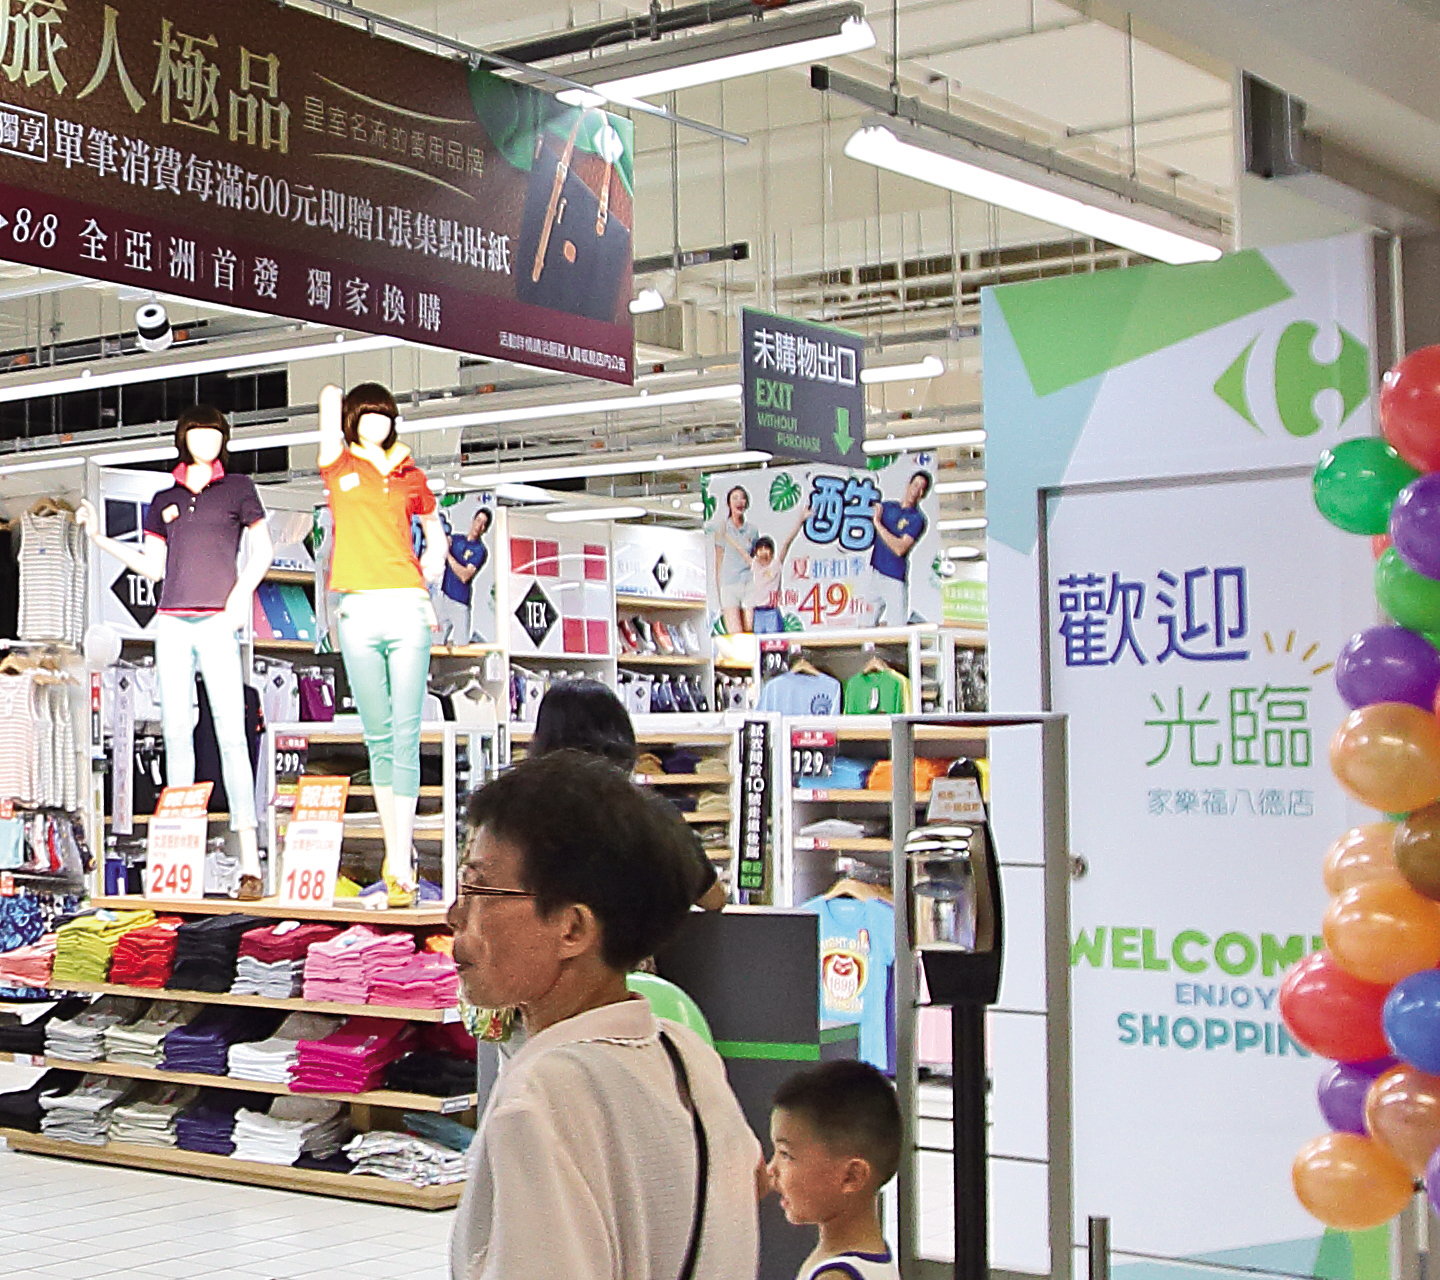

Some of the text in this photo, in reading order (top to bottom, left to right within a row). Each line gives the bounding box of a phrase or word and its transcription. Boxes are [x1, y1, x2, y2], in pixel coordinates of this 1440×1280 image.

[12, 207, 59, 249] 8/8
[306, 268, 442, 333] 獨家換購
[753, 327, 857, 387] 未購物出口
[756, 378, 795, 411] EXIT
[757, 412, 798, 433] WITHOUT
[776, 432, 821, 453] PURCHASE
[803, 475, 882, 551] 酷
[658, 562, 670, 580] TEX
[126, 574, 157, 606] TEX
[526, 601, 548, 629] TEX
[1057, 566, 1252, 668] 歡迎
[1144, 683, 1313, 768] 光臨
[276, 752, 299, 772] 299
[793, 751, 825, 774] 129
[300, 784, 343, 808] 報紙
[1146, 786, 1315, 817] 家樂福八德店
[151, 863, 193, 895] 249
[286, 869, 326, 901] 188
[1072, 925, 1324, 978] WELCOM
[1175, 982, 1278, 1011] ENJOY
[1116, 1011, 1311, 1058] SHOPPIN
